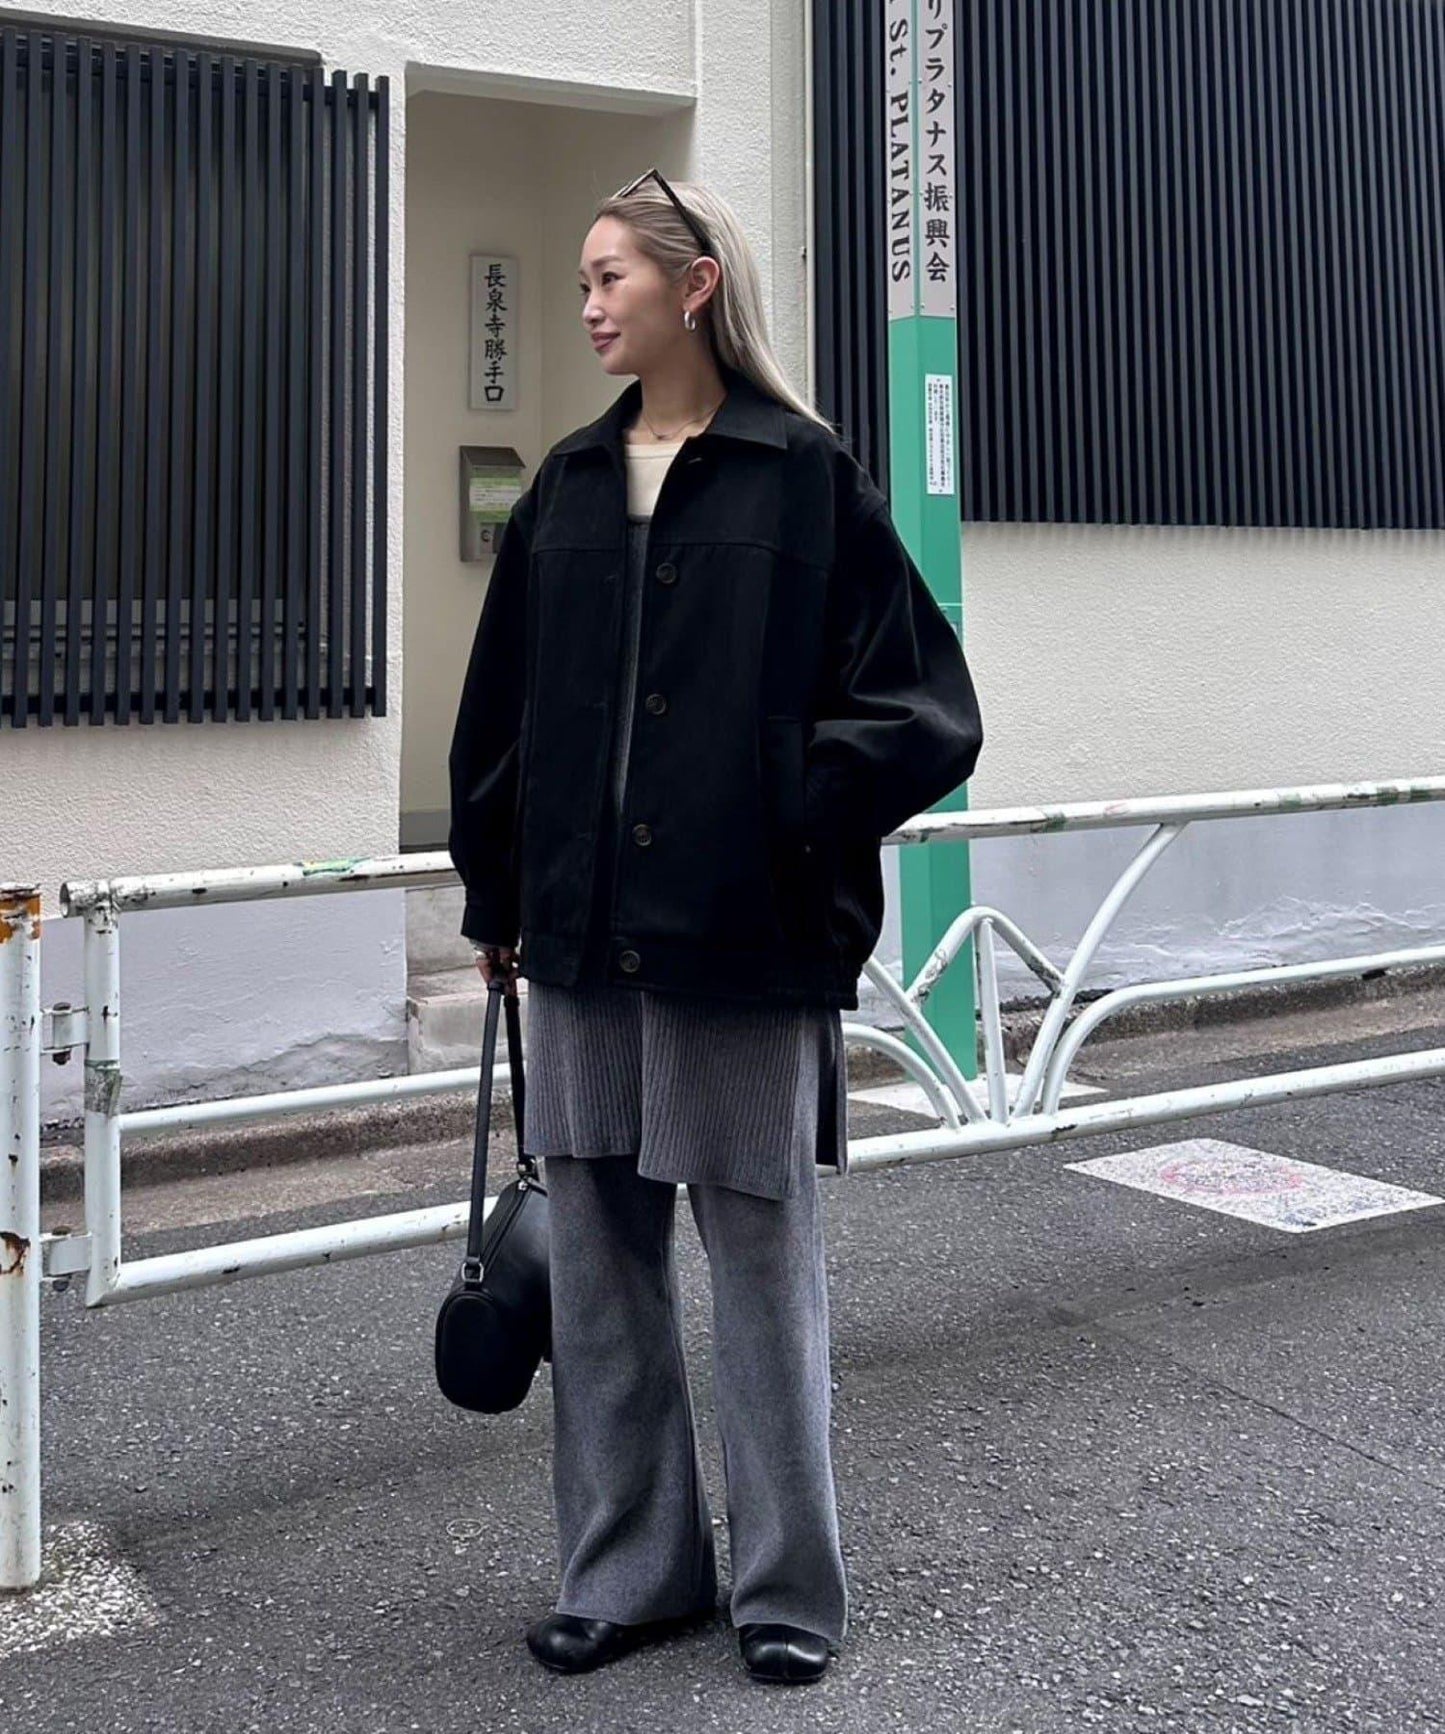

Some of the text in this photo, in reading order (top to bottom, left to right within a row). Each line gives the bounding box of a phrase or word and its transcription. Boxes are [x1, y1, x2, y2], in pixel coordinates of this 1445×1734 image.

[889, 18, 911, 282] St. PLATANUS
[484, 263, 508, 402] 長泉寺勝手口
